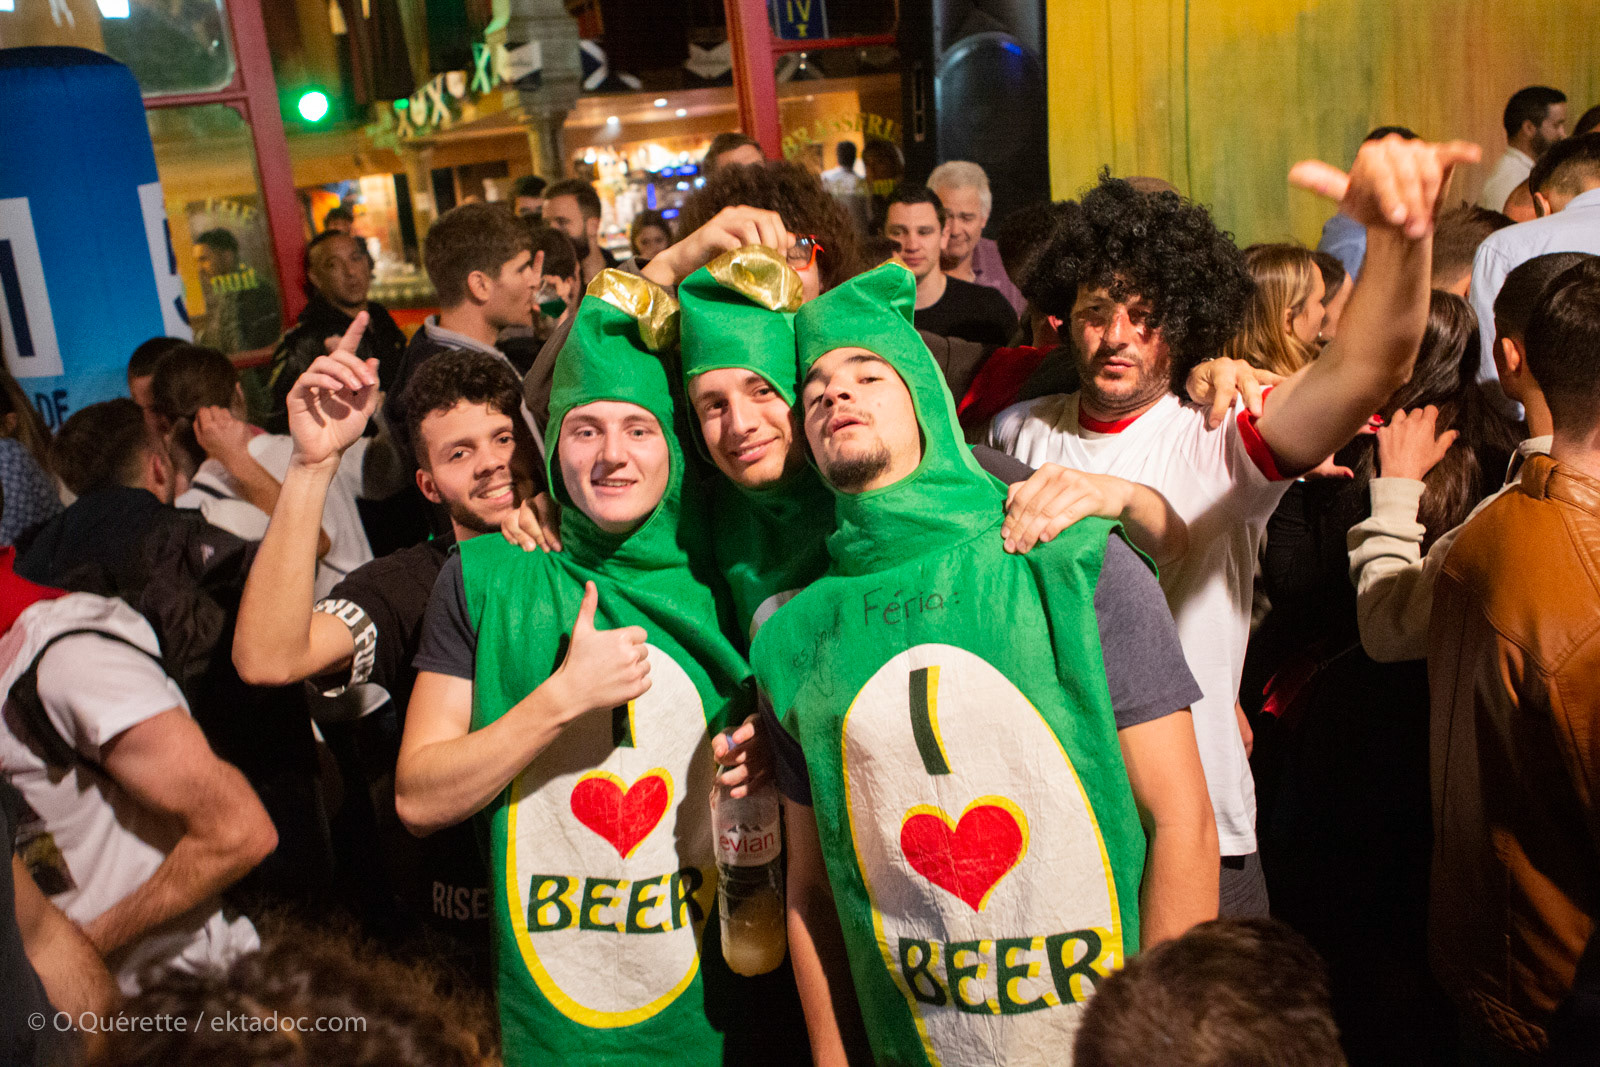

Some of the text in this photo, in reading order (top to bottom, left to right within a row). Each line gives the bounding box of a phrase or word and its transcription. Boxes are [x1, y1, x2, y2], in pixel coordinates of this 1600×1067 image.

[908, 665, 953, 775] I
[719, 832, 775, 853] evian
[527, 867, 704, 934] BEER
[899, 927, 1117, 1015] BEER
